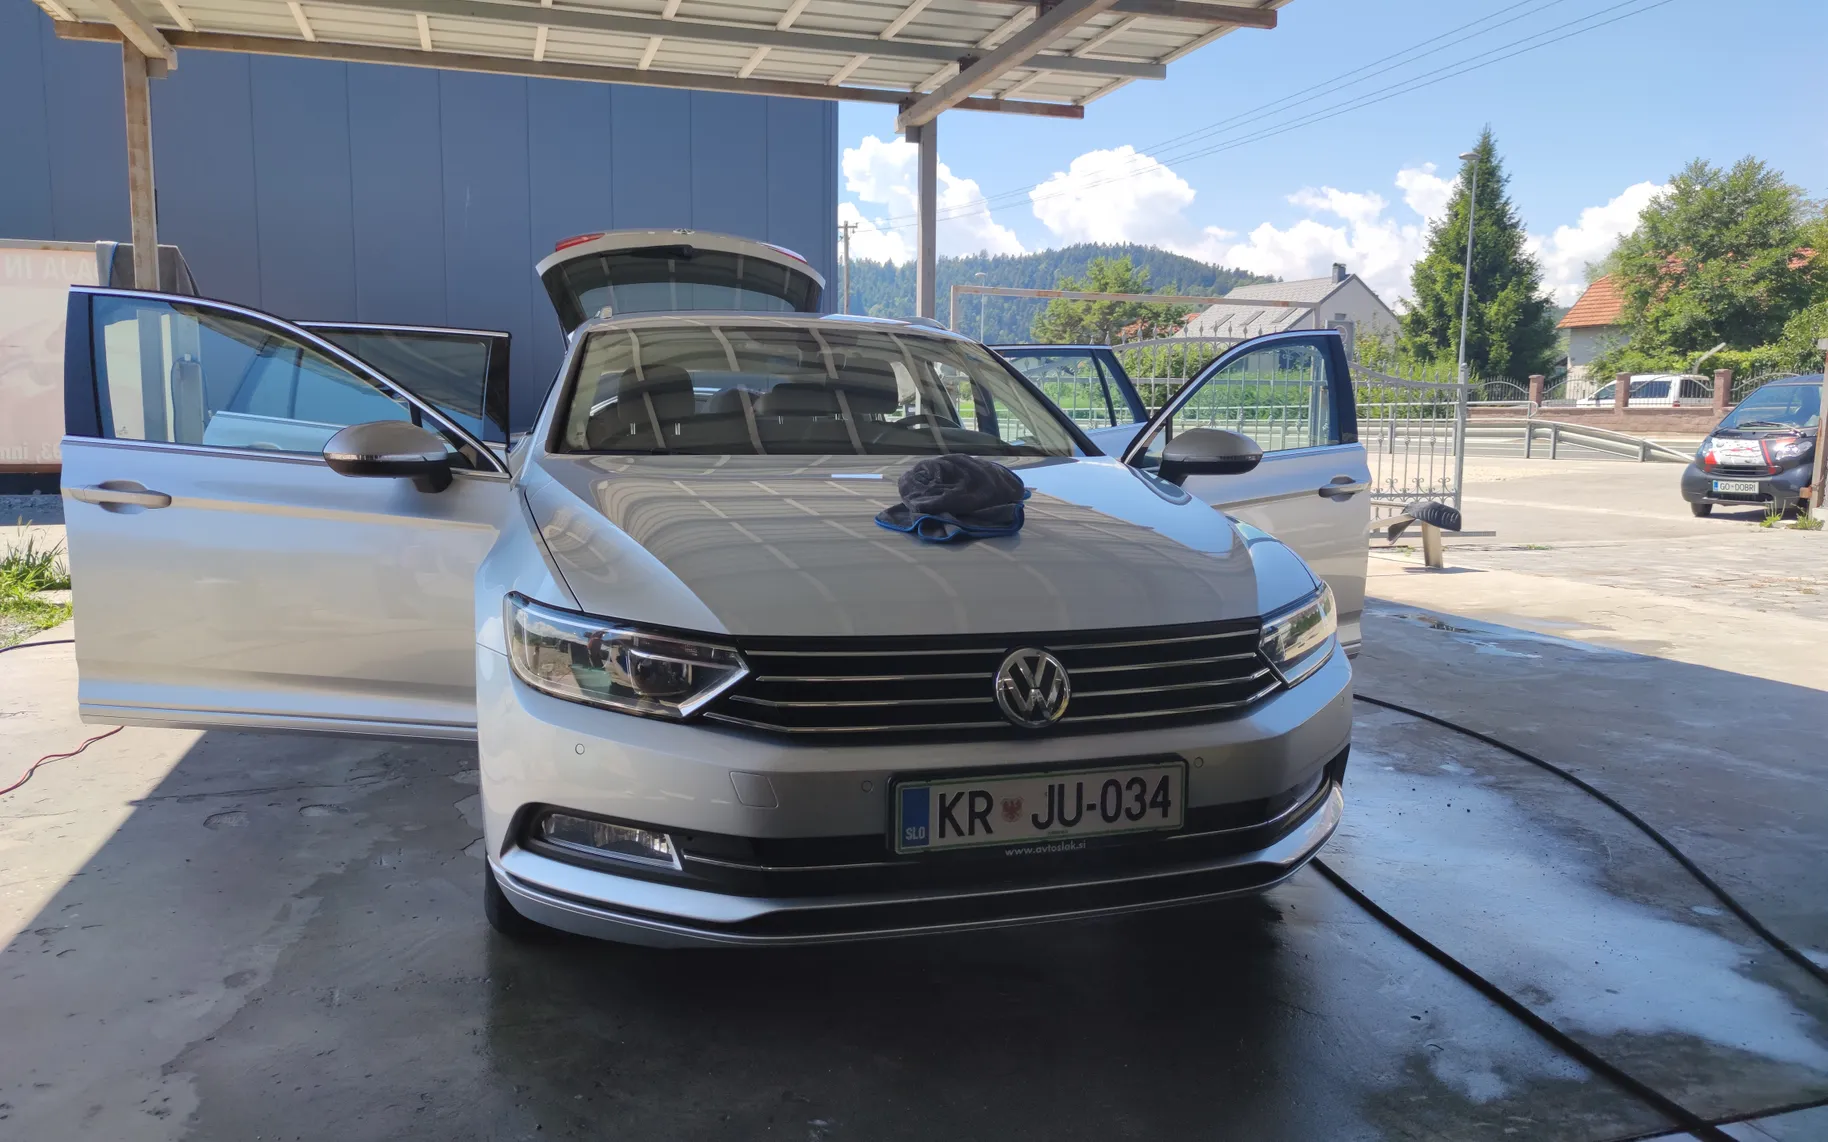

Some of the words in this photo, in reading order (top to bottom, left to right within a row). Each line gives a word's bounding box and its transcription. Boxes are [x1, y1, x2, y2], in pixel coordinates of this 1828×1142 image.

[937, 790, 994, 839] KR
[1031, 774, 1171, 830] JU-034
[905, 826, 926, 841] SLO
